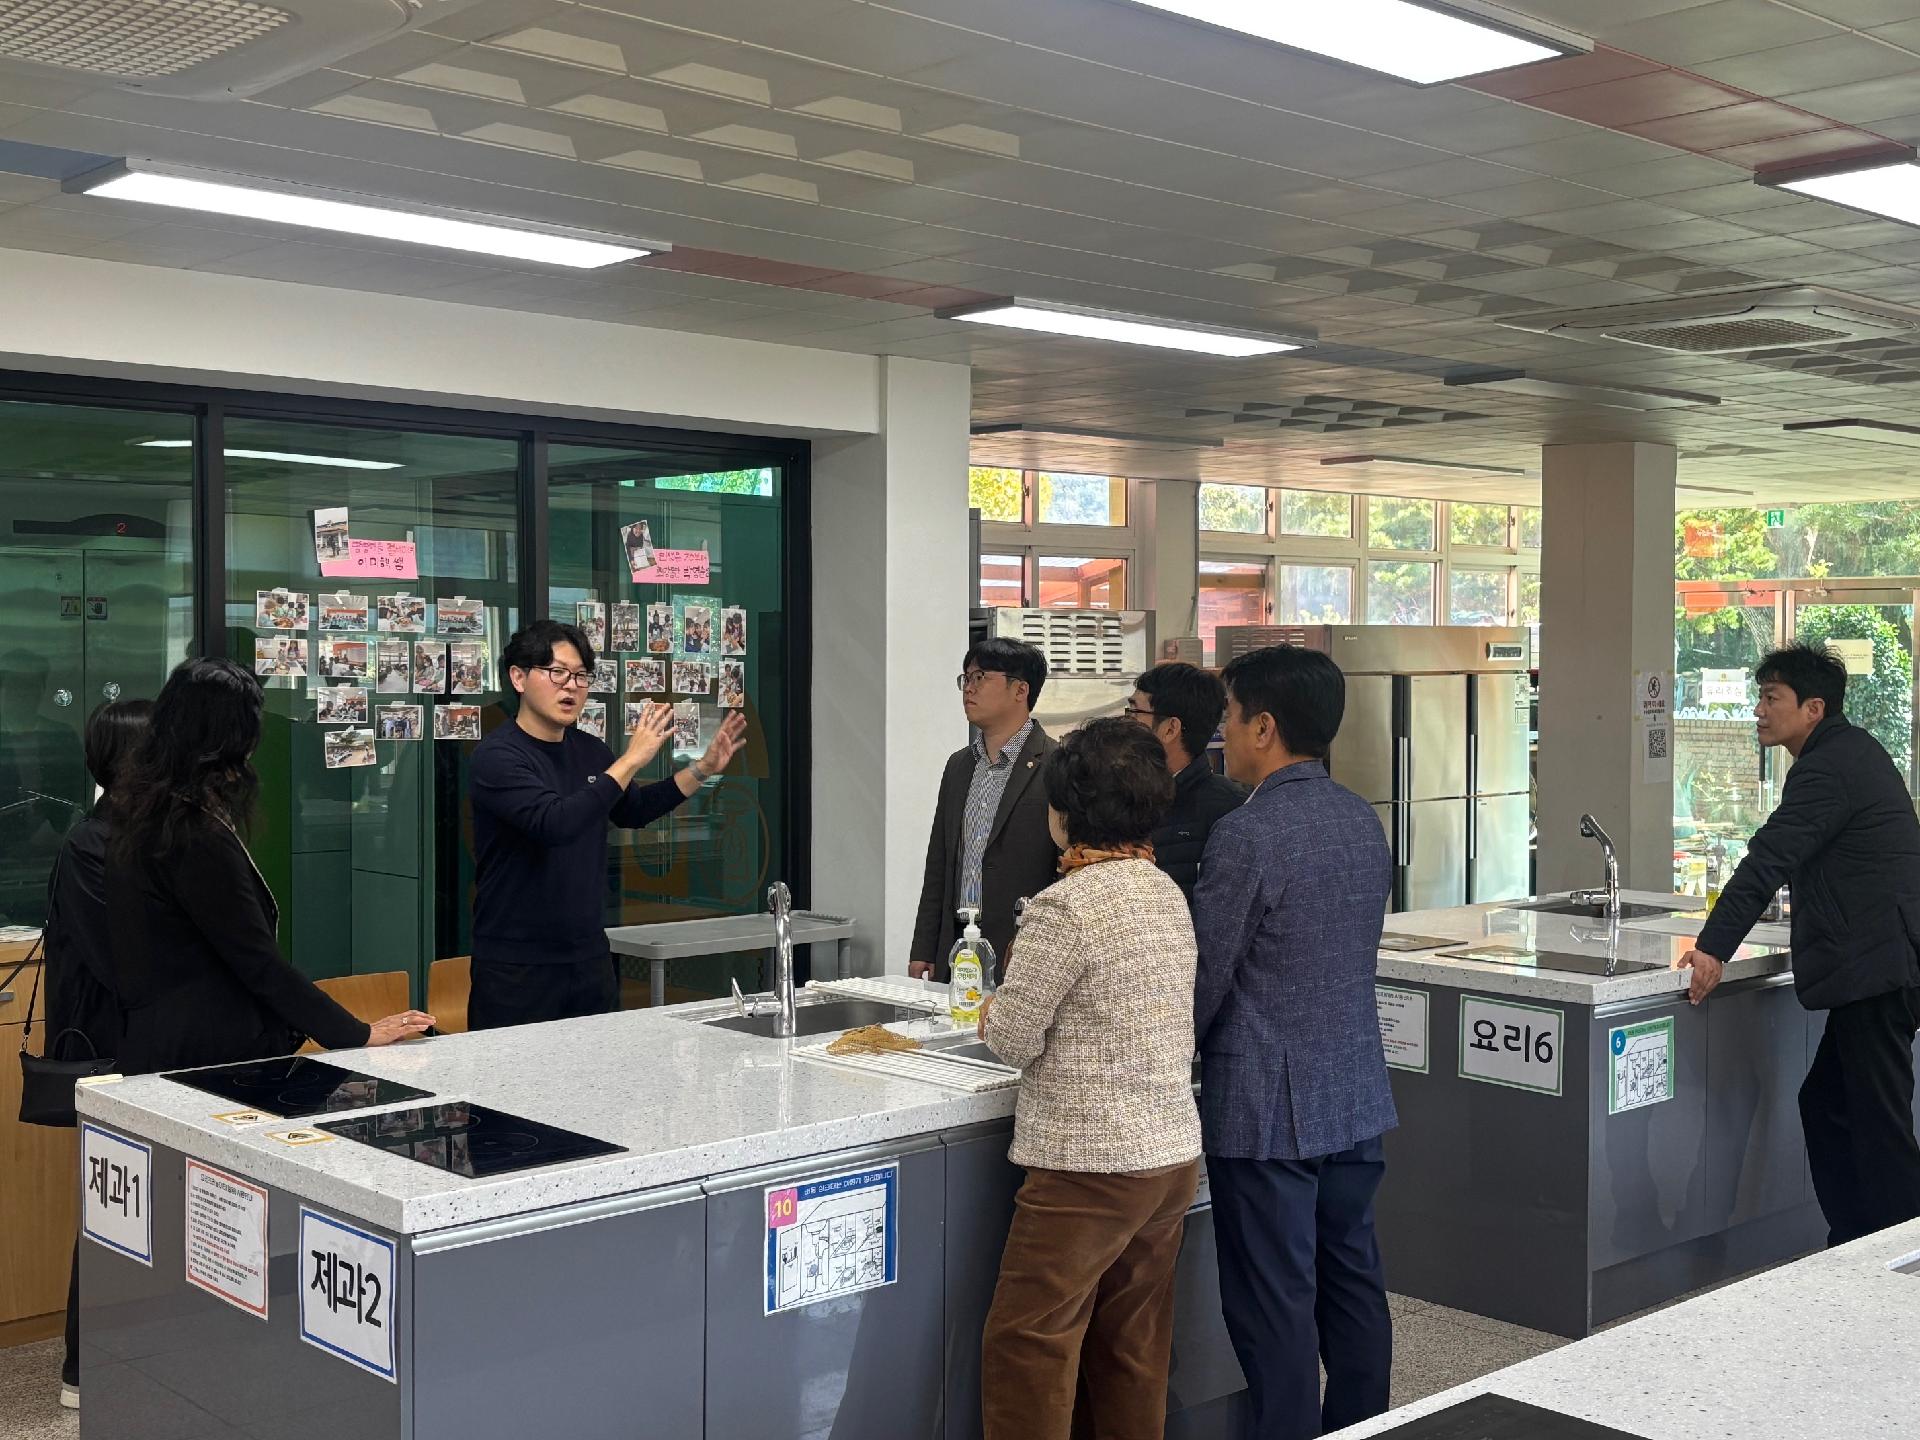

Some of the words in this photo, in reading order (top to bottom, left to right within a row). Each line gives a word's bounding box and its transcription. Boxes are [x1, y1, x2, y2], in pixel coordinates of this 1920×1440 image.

[1469, 1019, 1553, 1064] 요리6
[1615, 1036, 1622, 1049] 6
[88, 1156, 140, 1218] 제과1
[774, 1198, 792, 1218] 10
[310, 1248, 383, 1329] 제과2
